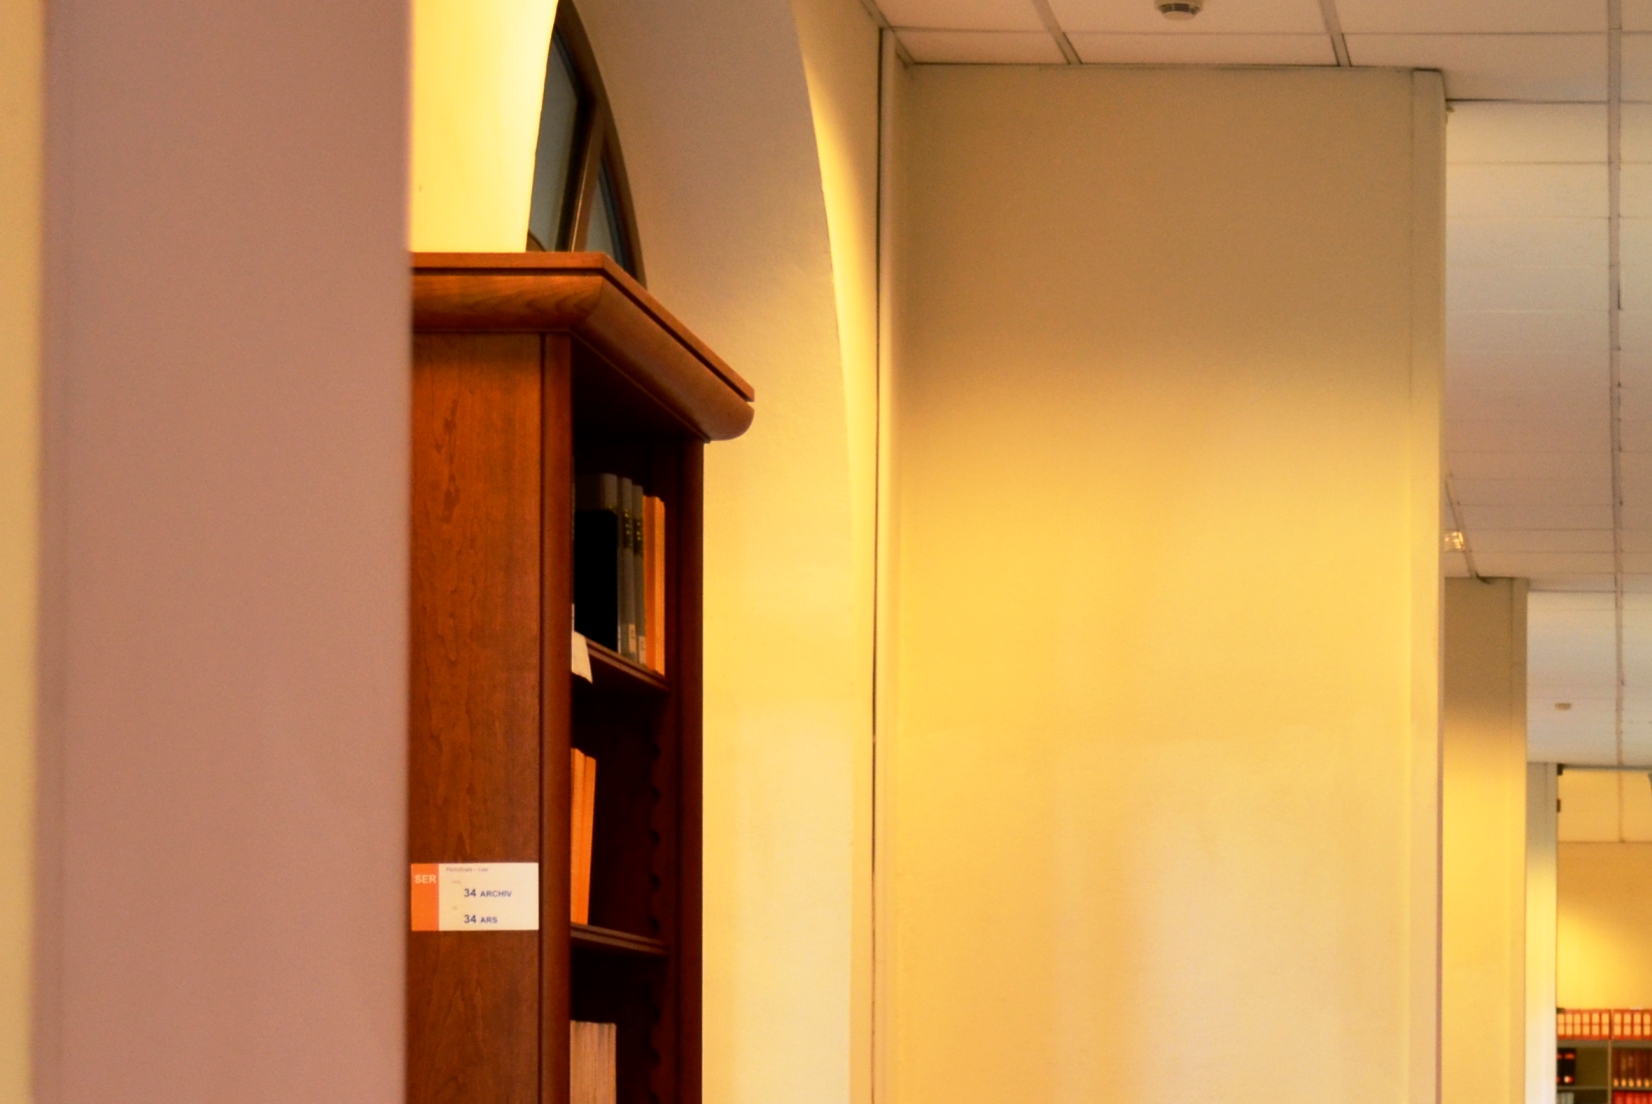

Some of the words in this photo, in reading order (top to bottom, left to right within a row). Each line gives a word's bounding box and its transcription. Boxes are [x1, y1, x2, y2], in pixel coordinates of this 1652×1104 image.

[415, 875, 436, 884] SER
[464, 889, 476, 897] 34
[464, 915, 477, 923] 34
